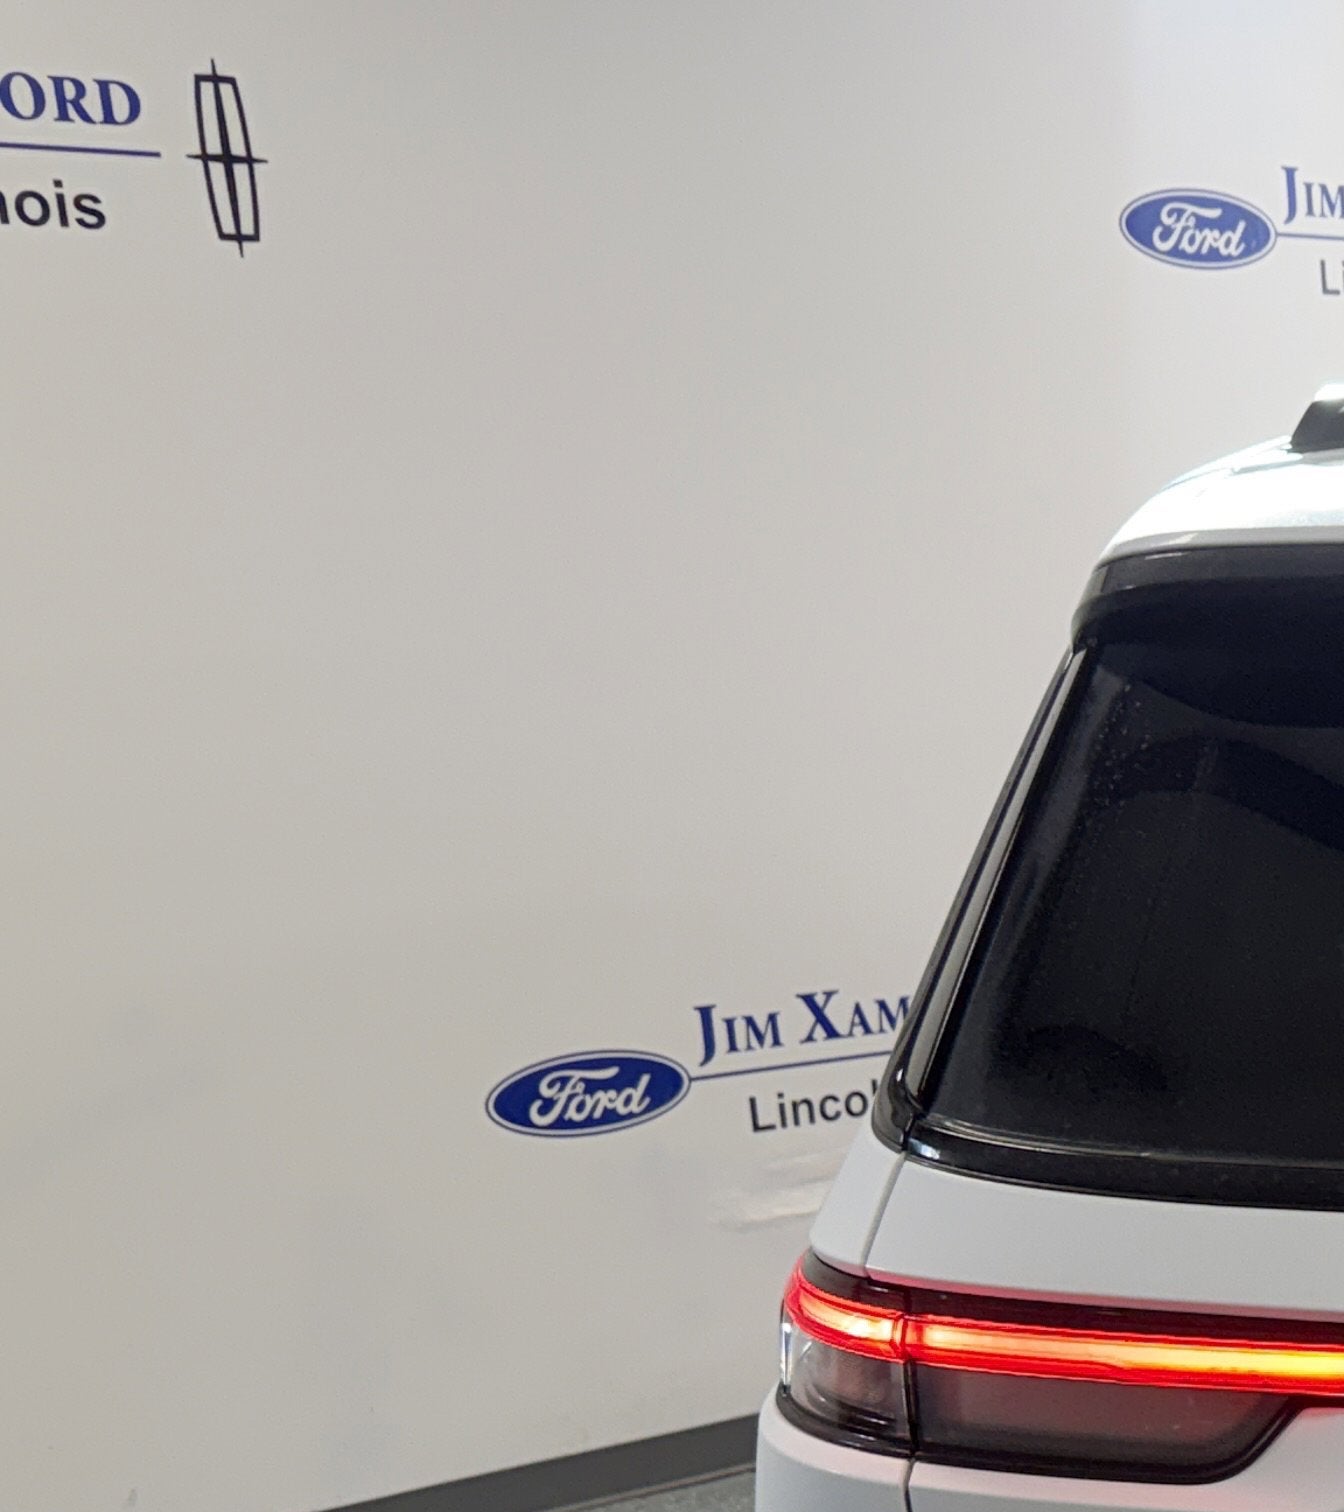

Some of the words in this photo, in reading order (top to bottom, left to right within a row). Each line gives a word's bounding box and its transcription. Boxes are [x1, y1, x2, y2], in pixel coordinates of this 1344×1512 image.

[0, 71, 142, 127] ORD
[1151, 201, 1246, 258] Ford
[692, 1003, 785, 1067] JIM
[794, 988, 911, 1045] XAM
[528, 1065, 652, 1127] Ford
[748, 1078, 879, 1133] Linco
